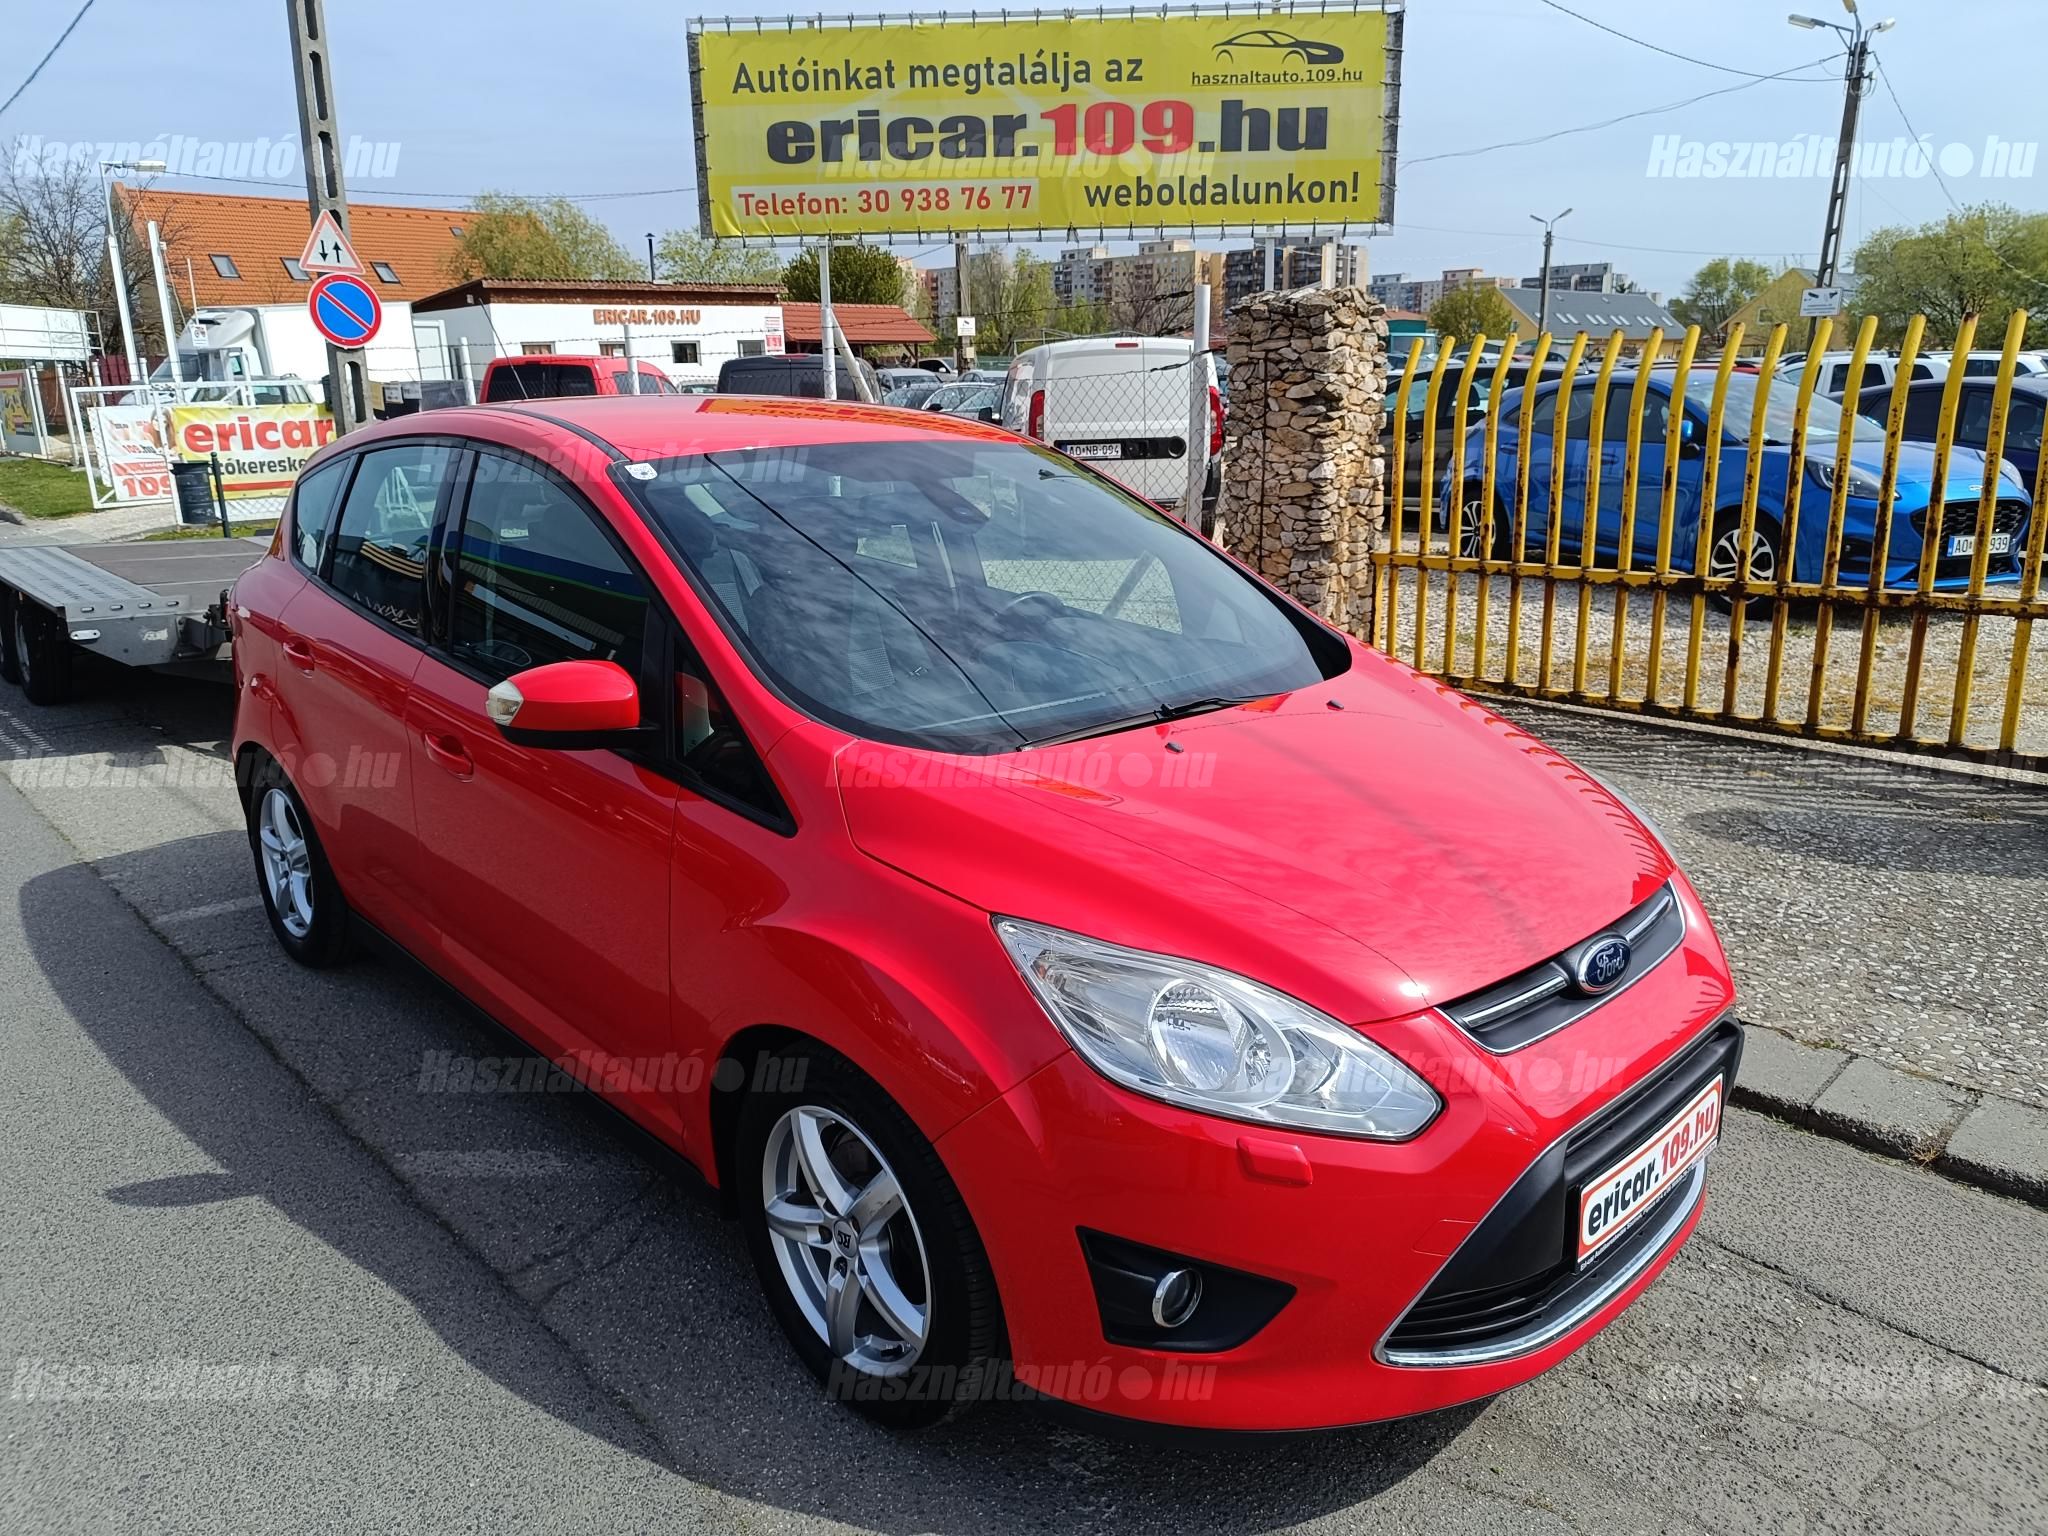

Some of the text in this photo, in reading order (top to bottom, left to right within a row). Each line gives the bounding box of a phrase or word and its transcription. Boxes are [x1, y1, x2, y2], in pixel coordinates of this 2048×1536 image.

[732, 48, 1144, 95] Autóinkat megtalálja az
[1191, 68, 1364, 86] hasznaltauto.109.hu
[766, 99, 1328, 165] ericar.109.hu
[738, 184, 1033, 217] Telefon: 30 938 76 77
[1083, 171, 1360, 208] weboldalunkon!
[592, 308, 701, 326] ERICAR.109.HU
[183, 415, 335, 454] ericar
[1595, 946, 1625, 982] Ford
[1586, 1101, 1715, 1238] ericar.109.hu
